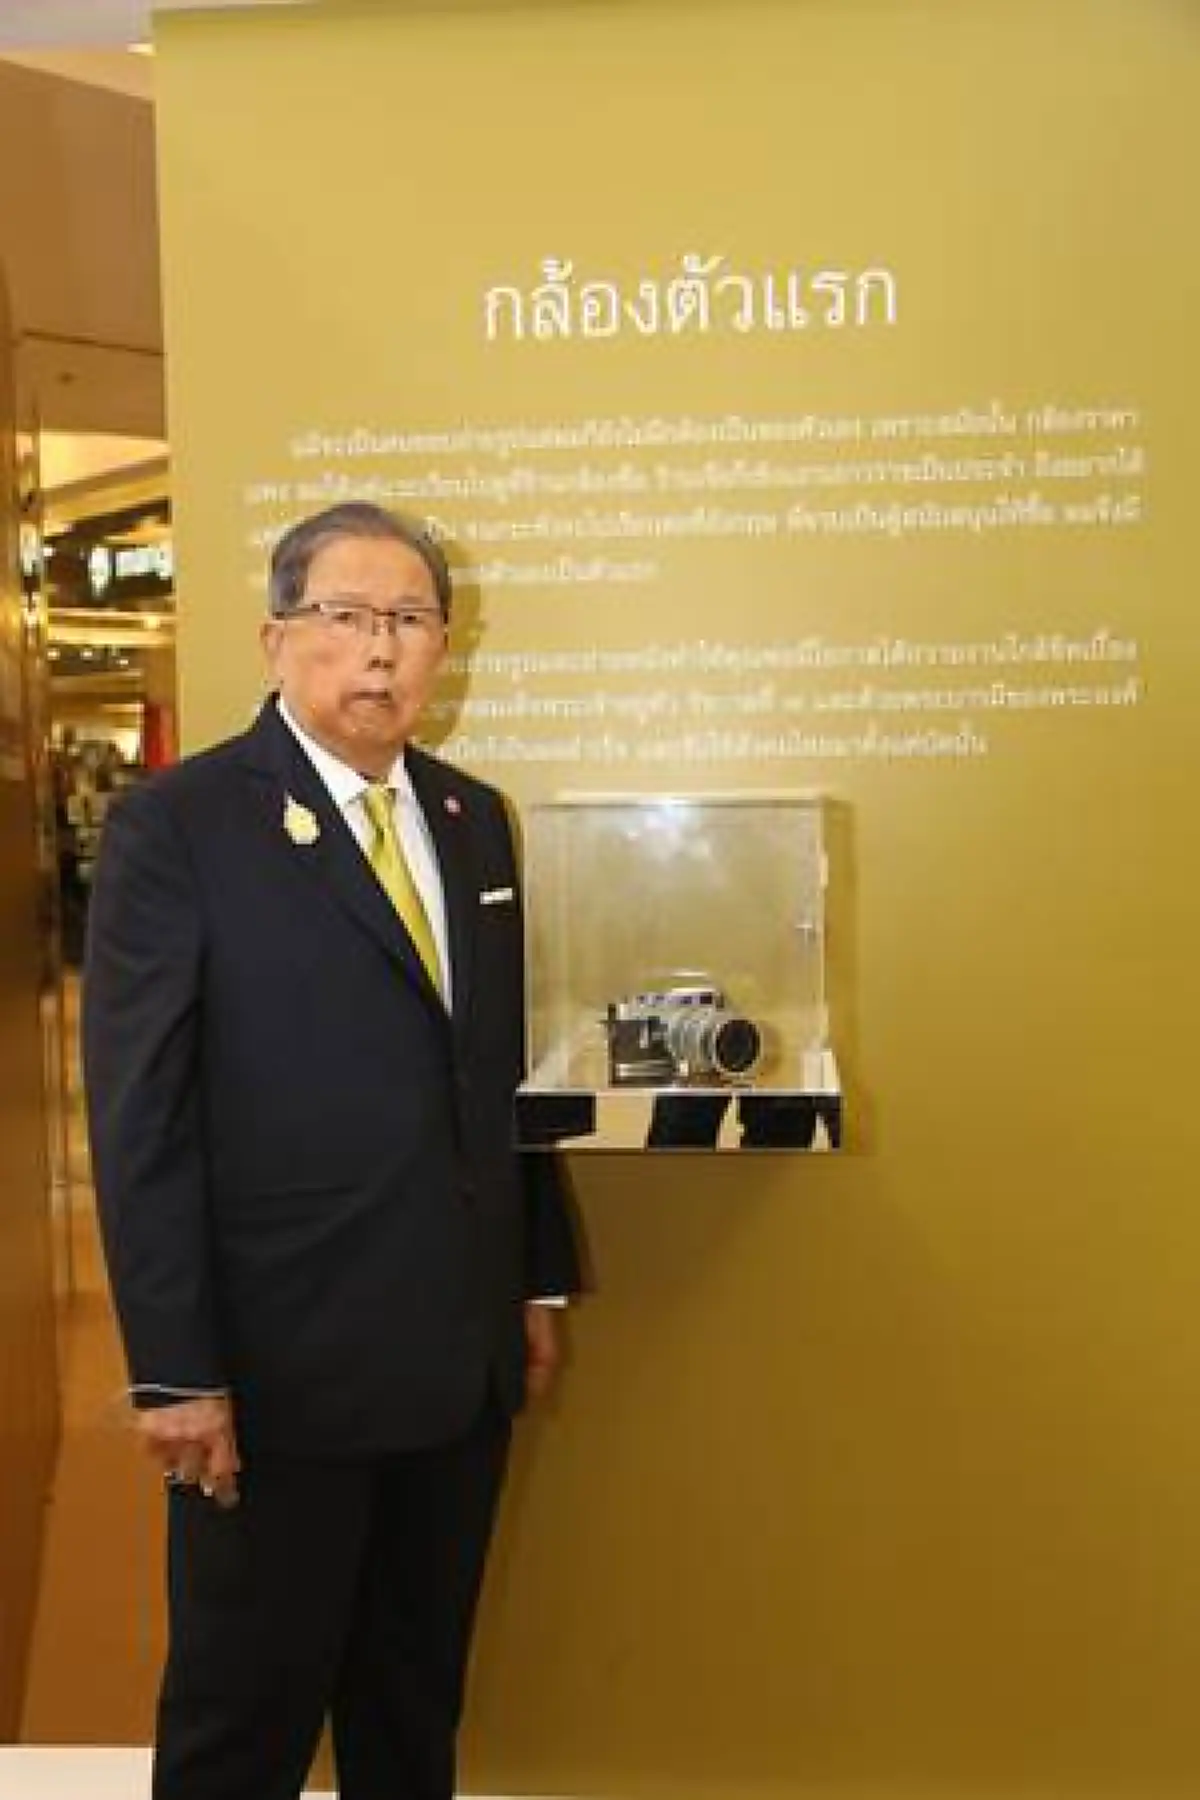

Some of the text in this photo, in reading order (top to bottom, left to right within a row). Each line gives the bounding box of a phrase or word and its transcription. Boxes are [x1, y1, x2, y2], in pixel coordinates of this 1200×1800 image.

[484, 254, 897, 341] กล้องตัวแรก
